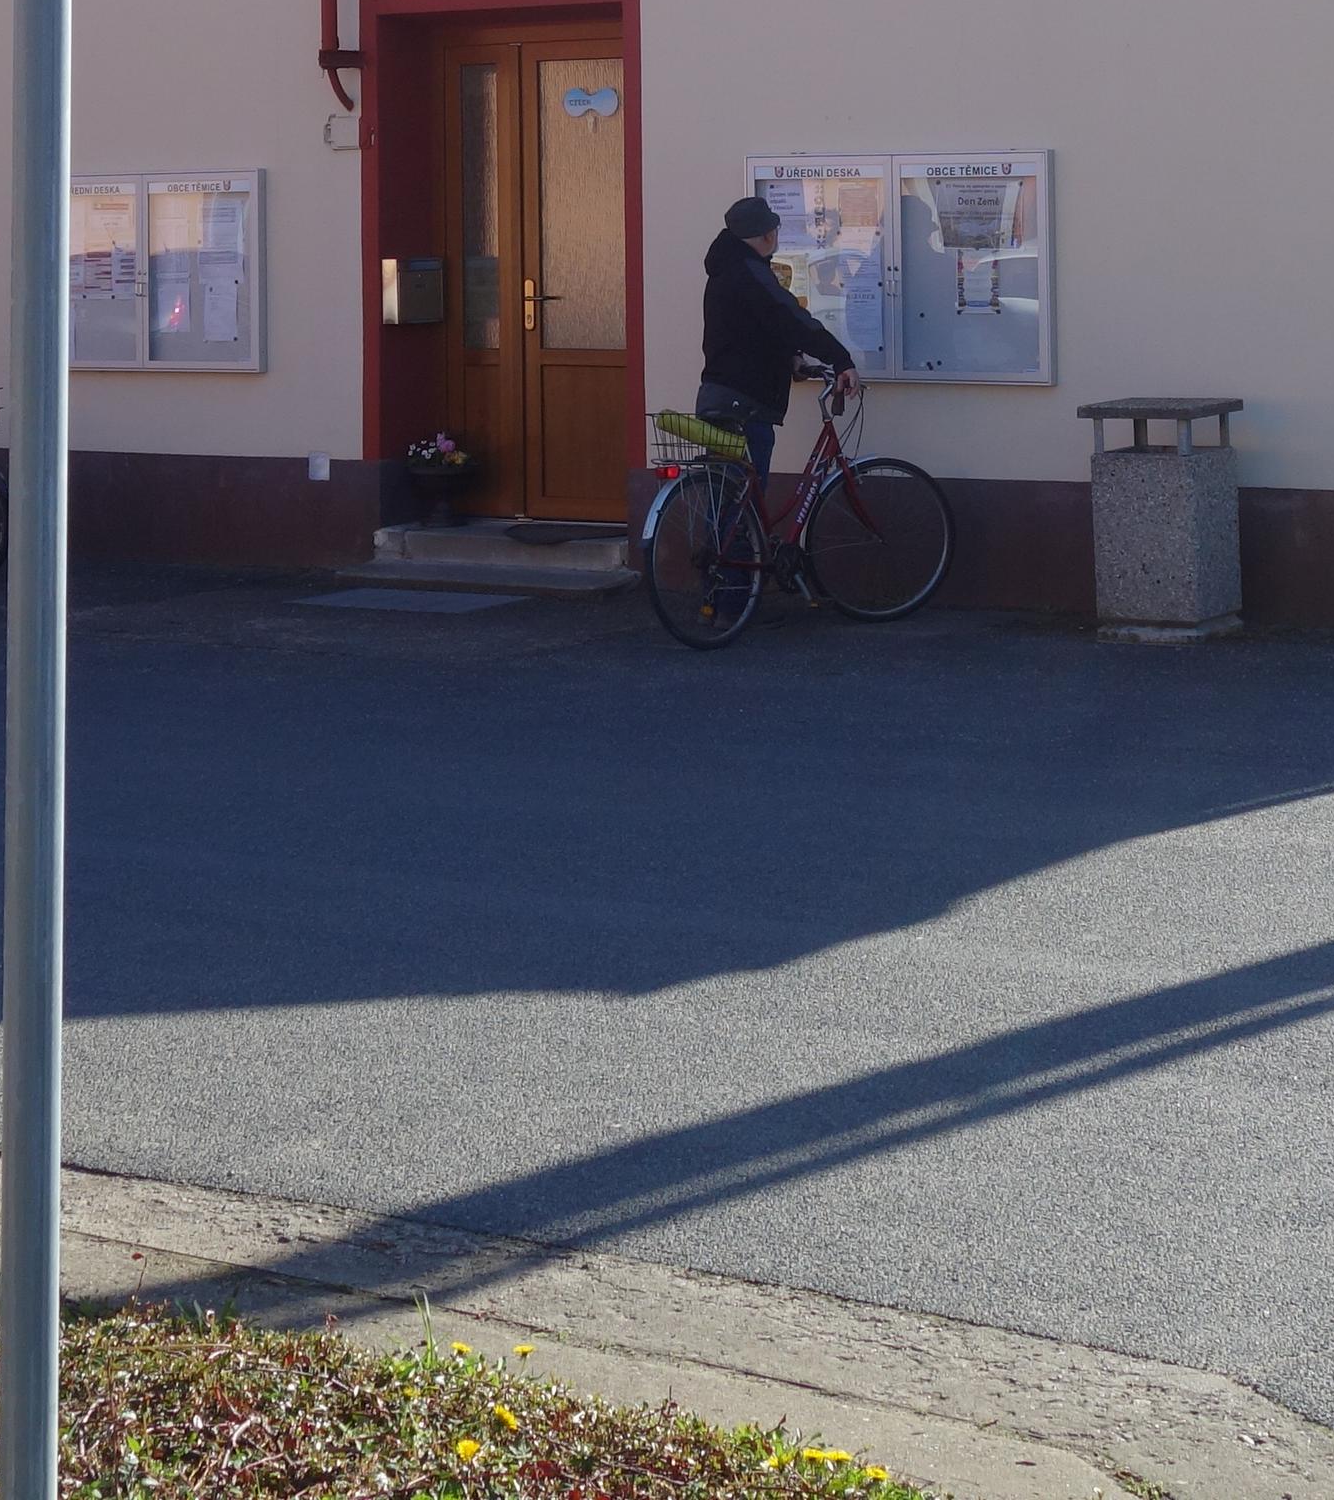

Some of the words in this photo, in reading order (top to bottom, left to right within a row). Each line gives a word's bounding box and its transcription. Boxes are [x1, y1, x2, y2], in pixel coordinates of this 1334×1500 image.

[826, 168, 861, 177] DESKA
[927, 167, 956, 176] OBCE
[959, 165, 998, 175] TĚMICE
[94, 186, 120, 194] DESKA
[167, 184, 189, 192] OBCE
